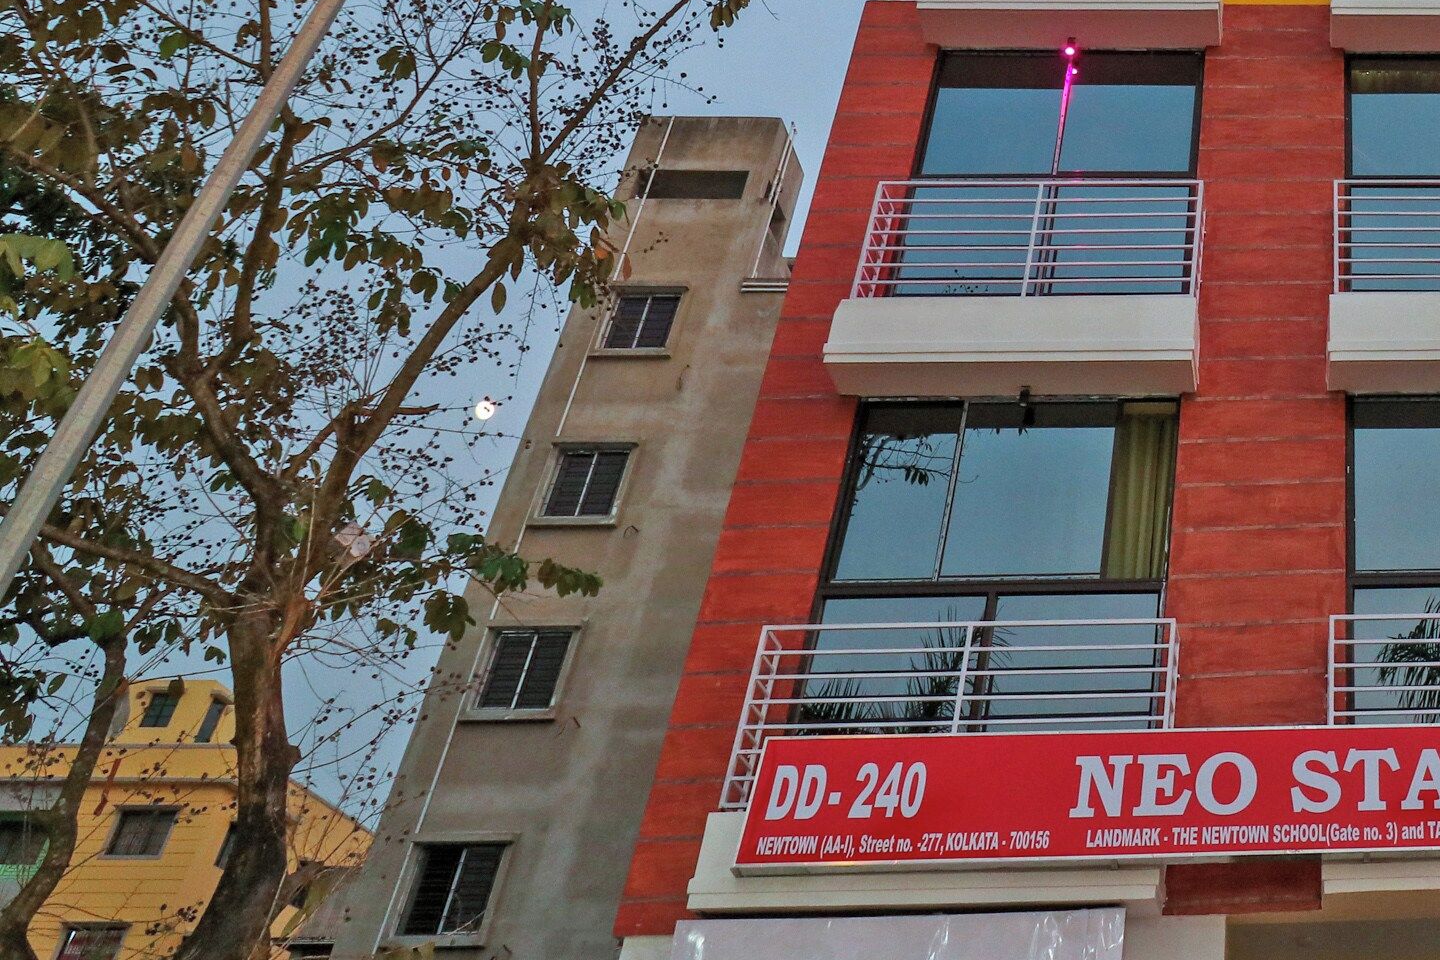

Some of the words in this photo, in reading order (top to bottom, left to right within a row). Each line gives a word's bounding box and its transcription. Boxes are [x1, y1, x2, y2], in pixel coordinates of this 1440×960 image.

[848, 761, 927, 819] 240
[1068, 751, 1258, 818] NEO
[755, 835, 819, 856] NEWTOWN
[858, 834, 895, 854] Street
[895, 838, 913, 853] no.
[1009, 830, 1050, 851] 700156
[1085, 827, 1161, 848] LANDMARK
[1171, 827, 1199, 846] THE
[1201, 825, 1269, 845] NEWTOWN
[1363, 826, 1382, 841] no.
[1385, 821, 1398, 845] 3)
[1401, 820, 1425, 840] and
